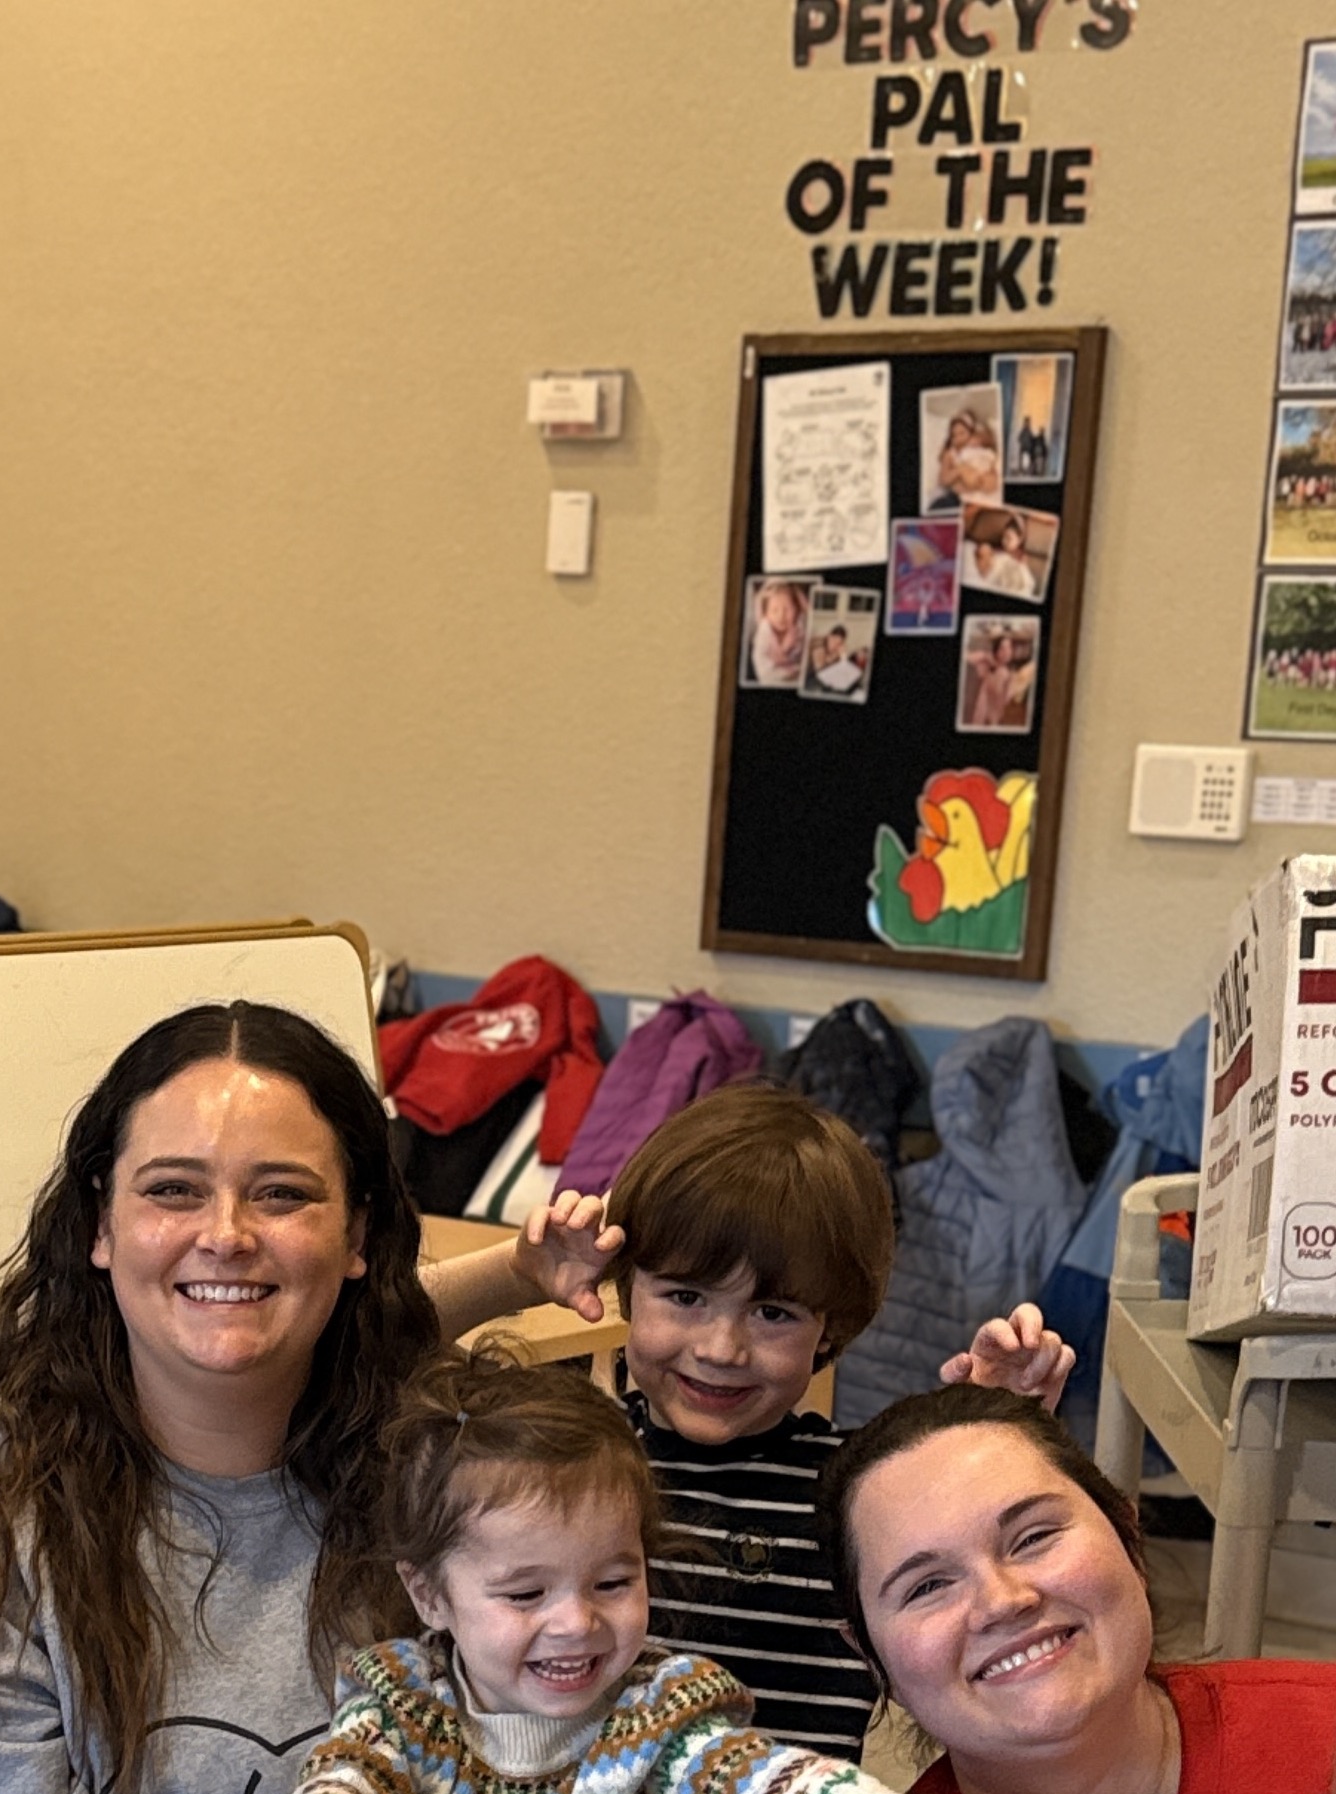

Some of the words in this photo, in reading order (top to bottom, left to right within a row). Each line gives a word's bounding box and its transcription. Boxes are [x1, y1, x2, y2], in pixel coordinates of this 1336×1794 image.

[794, 0, 1136, 67] PERCYS
[871, 68, 1023, 149] PAL
[786, 158, 894, 235] OF
[936, 148, 1093, 229] THE
[810, 236, 1058, 318] WEEK!
[1297, 1247, 1333, 1261] PACK
